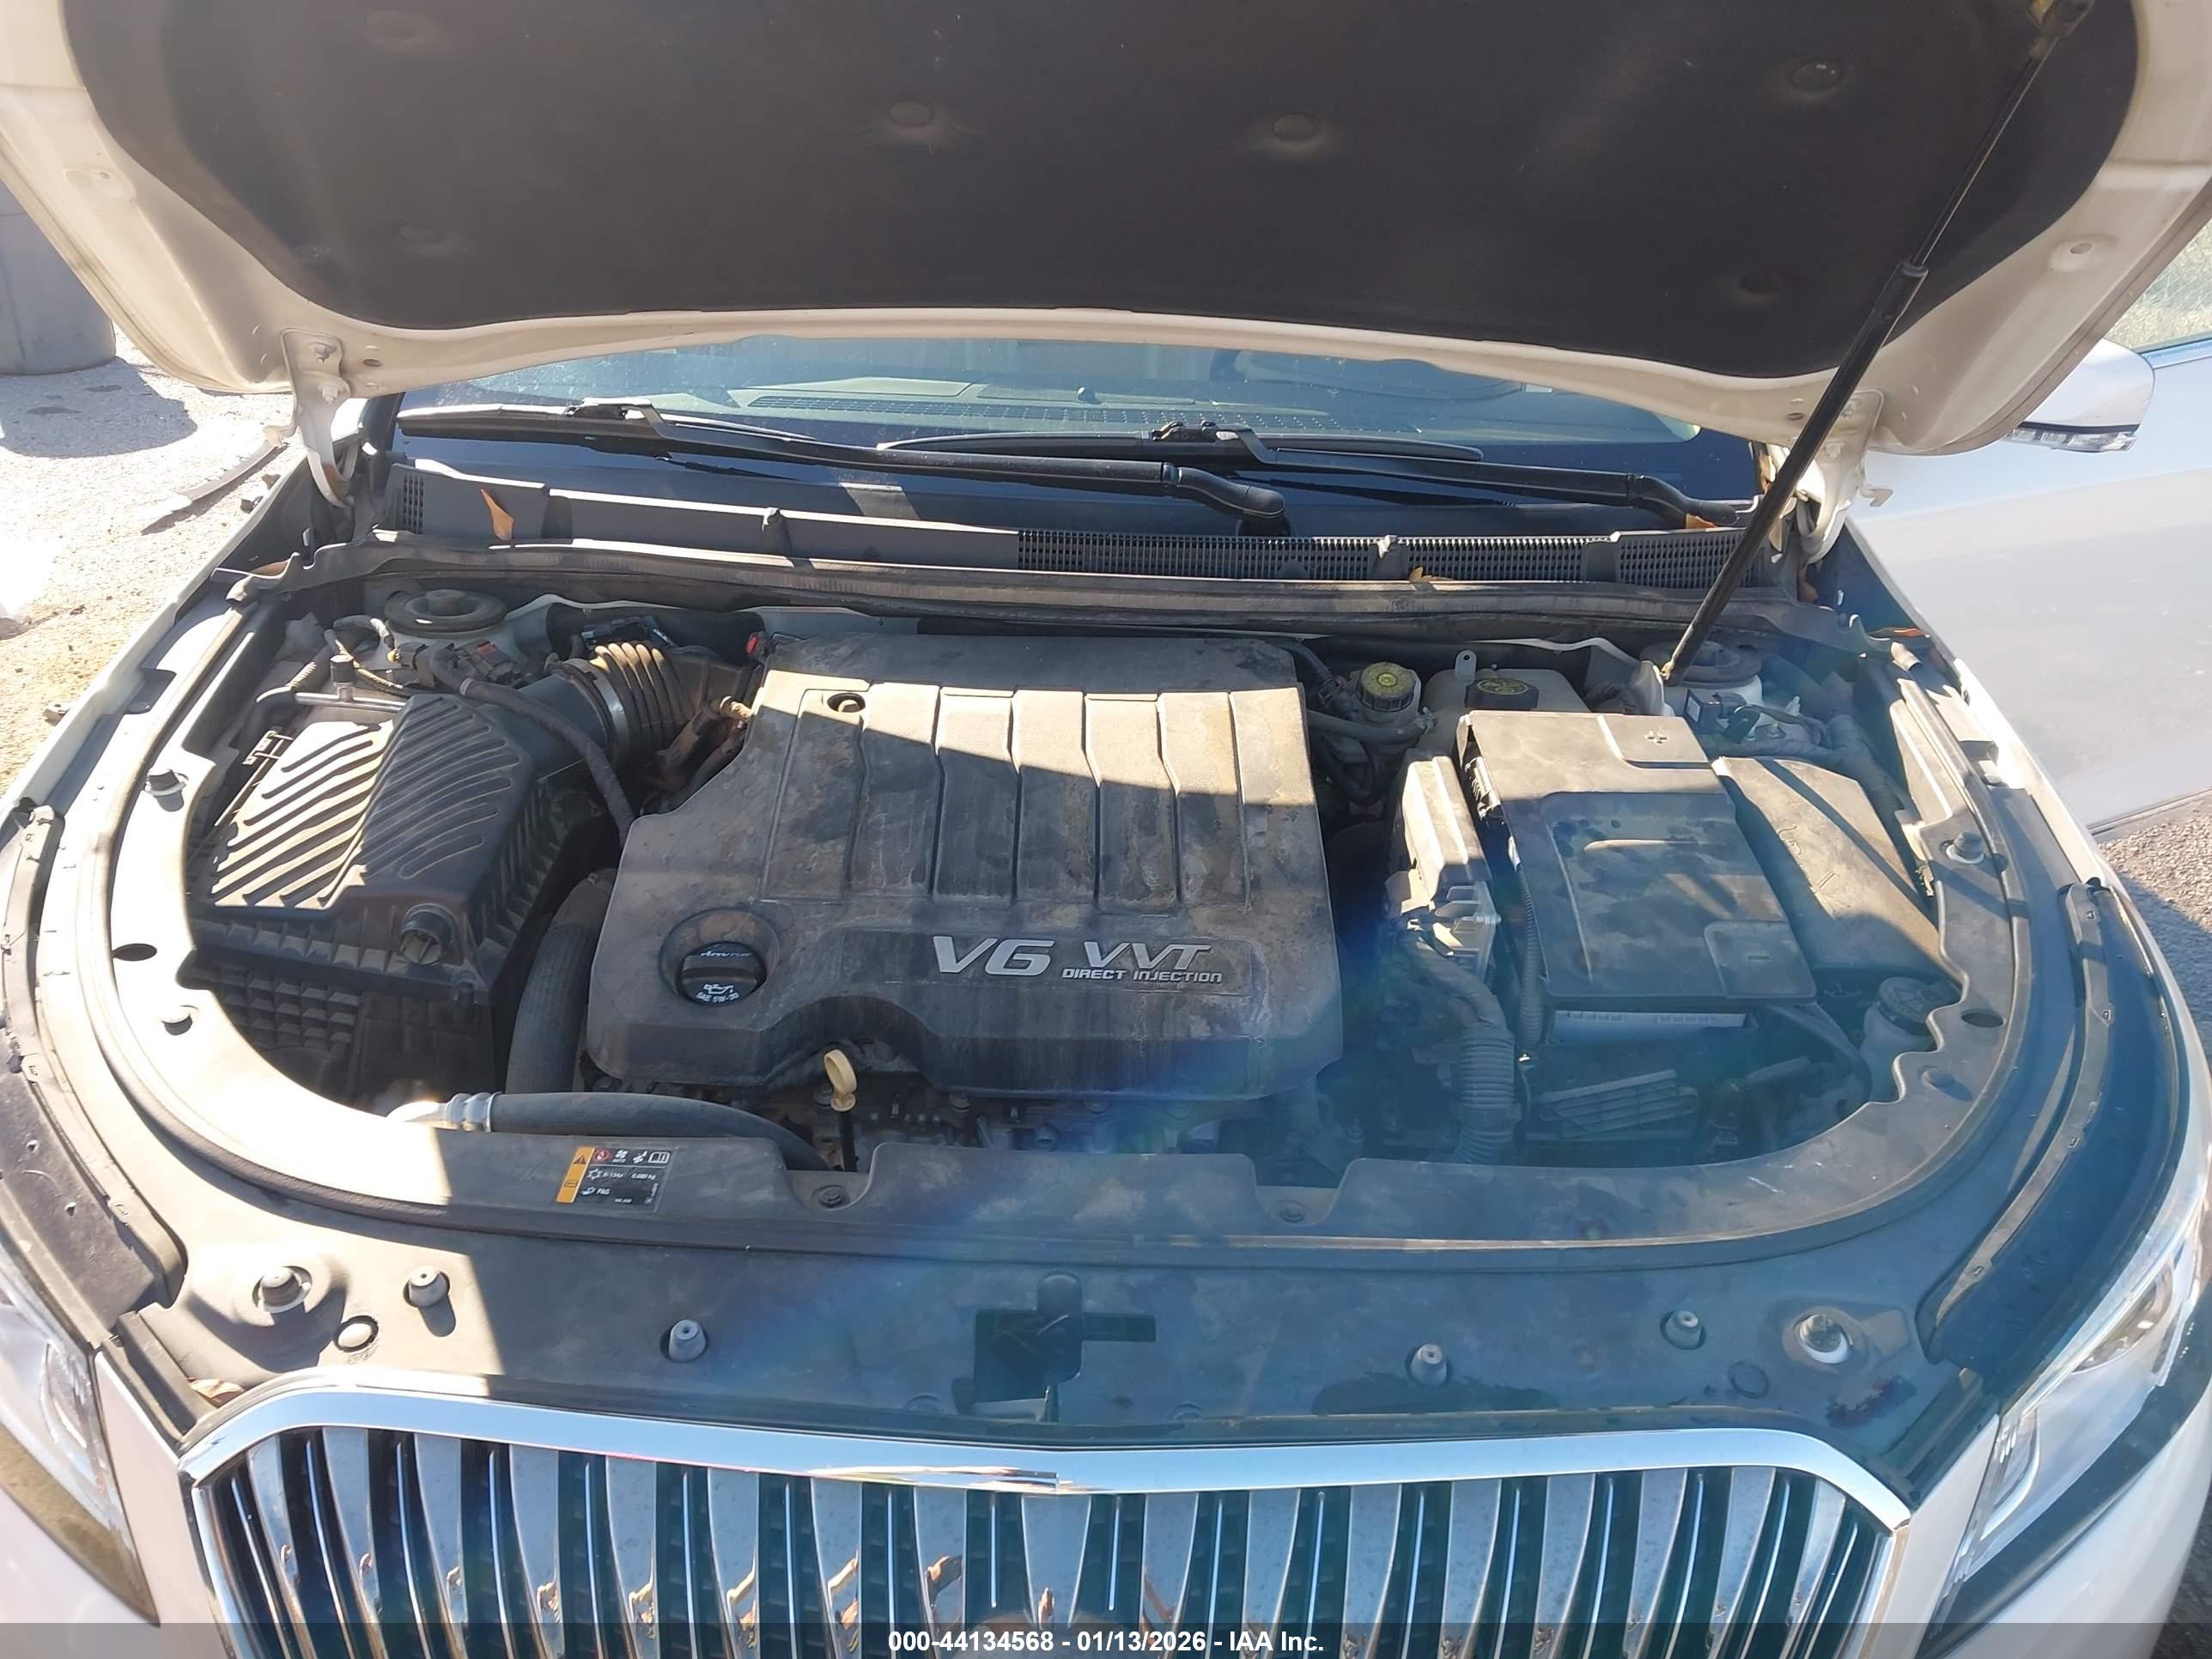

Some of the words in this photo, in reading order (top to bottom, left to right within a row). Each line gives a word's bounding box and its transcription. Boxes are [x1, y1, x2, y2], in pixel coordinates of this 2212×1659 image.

[933, 936, 1054, 976] V6
[1084, 941, 1211, 970] VVT
[1062, 968, 1127, 981] DIRECT
[1133, 970, 1223, 983] INJECTION
